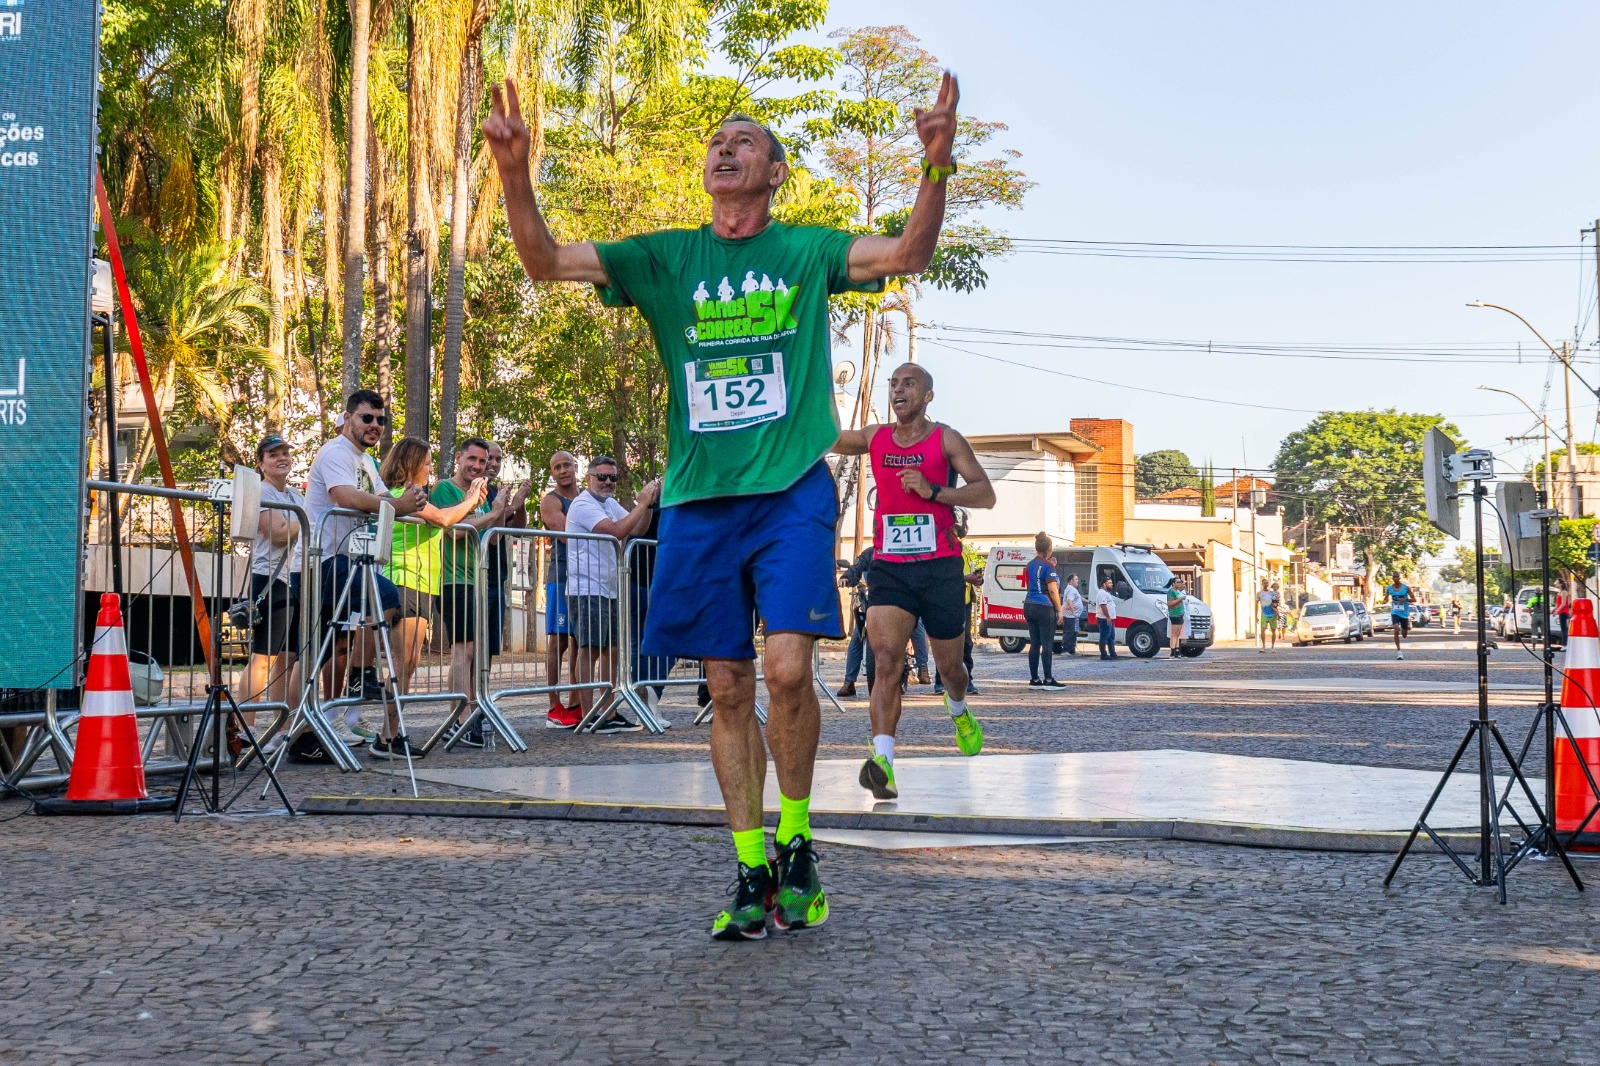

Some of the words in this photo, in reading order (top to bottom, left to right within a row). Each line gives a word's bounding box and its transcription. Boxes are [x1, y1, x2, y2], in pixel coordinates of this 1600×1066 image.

[695, 298, 745, 320] VAMOS
[744, 285, 799, 335] 5K
[696, 317, 752, 341] CORRER
[699, 338, 725, 348] PRIMEIRA
[725, 336, 750, 345] CORRIDA
[761, 333, 773, 341] RUA
[727, 357, 749, 376] 5K
[703, 378, 767, 412] 152
[892, 527, 922, 543] 211
